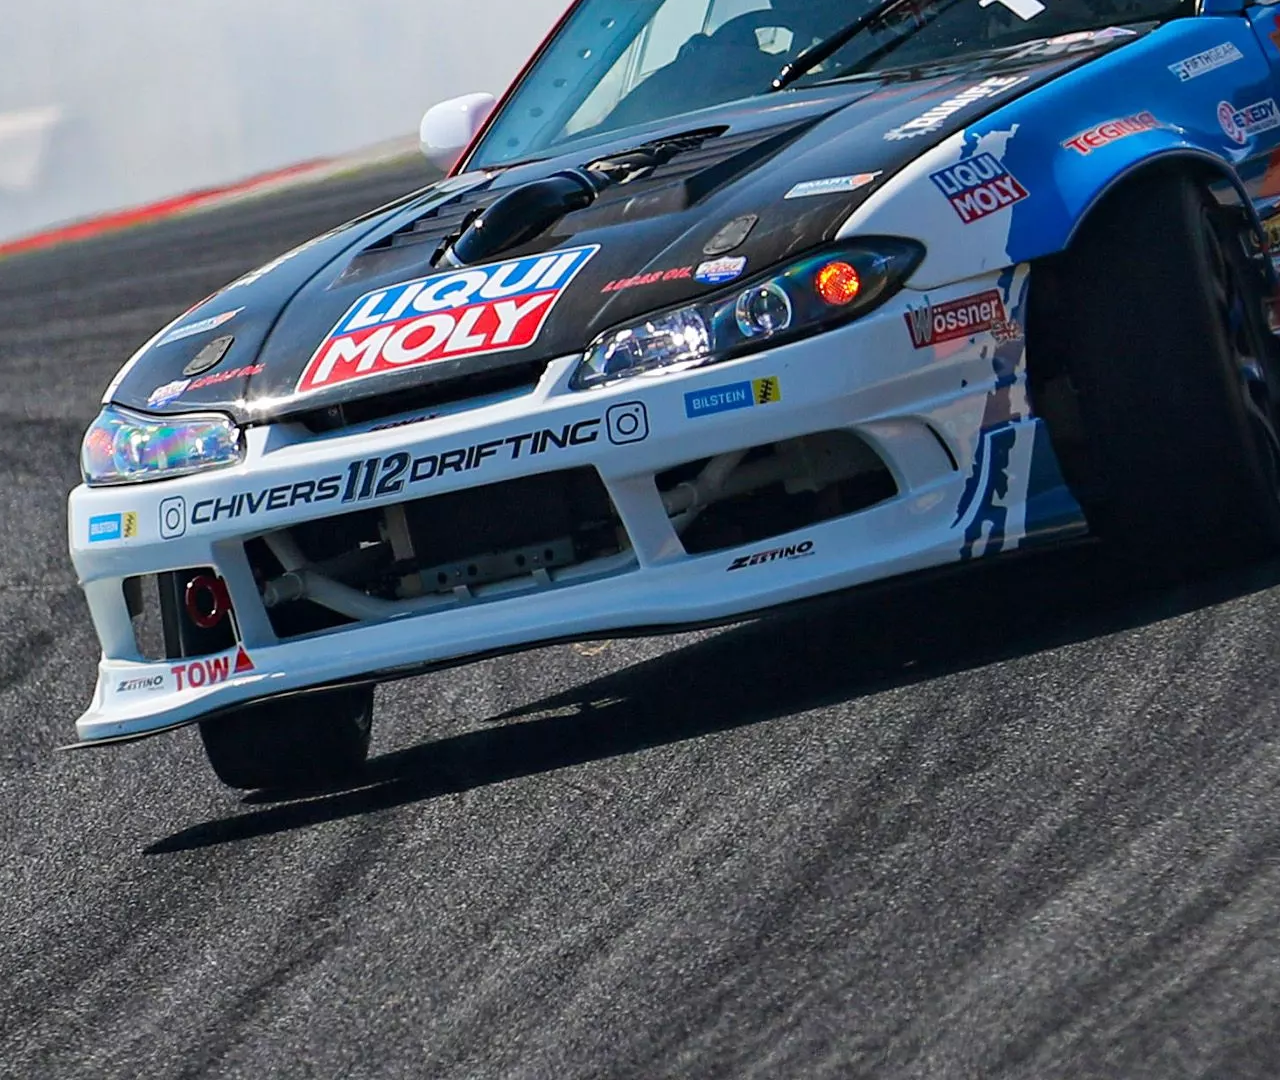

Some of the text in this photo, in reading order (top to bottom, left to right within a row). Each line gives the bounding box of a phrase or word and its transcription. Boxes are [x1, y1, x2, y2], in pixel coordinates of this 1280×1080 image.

[1233, 101, 1274, 128] EXEDY
[934, 154, 1002, 194] LIQUI
[953, 175, 1020, 220] MOLY
[343, 249, 582, 332] LIQUI
[311, 291, 556, 386] MOLY
[906, 295, 999, 345] Wössner
[692, 389, 746, 410] BILSTEIN
[191, 474, 342, 524] CHIVERS
[341, 452, 411, 503] 112
[410, 418, 602, 483] DRIFTING
[726, 540, 814, 572] ZESTINO
[171, 655, 230, 692] TOW
